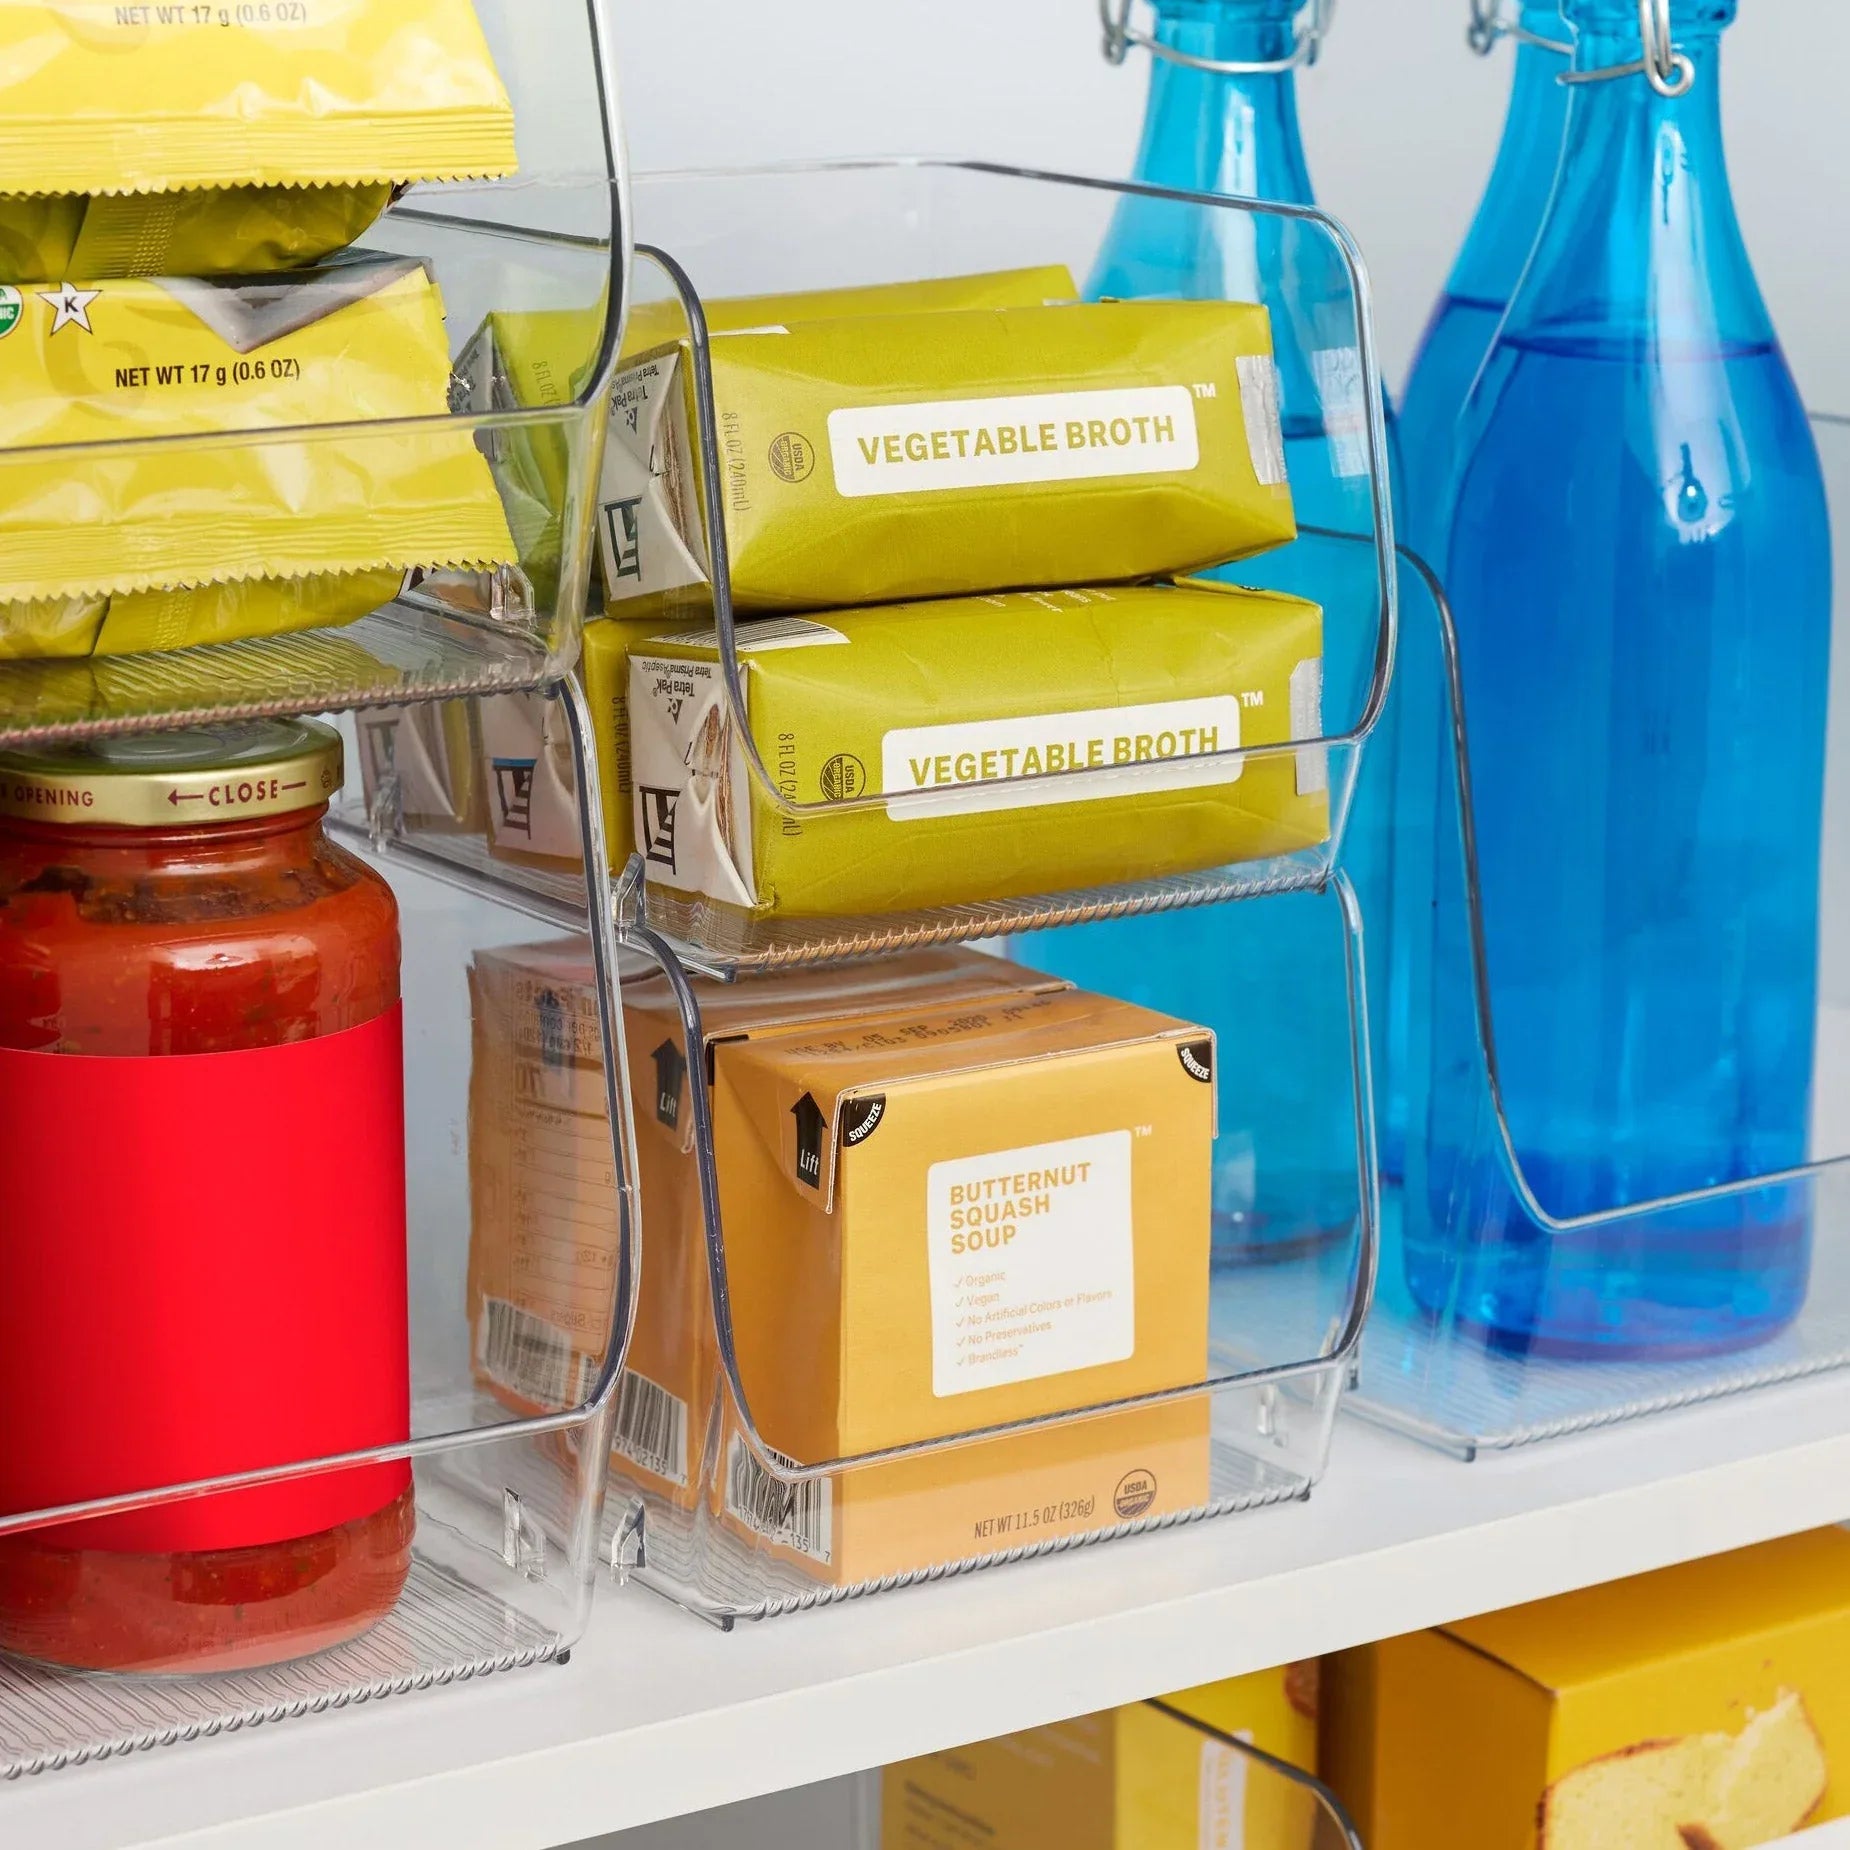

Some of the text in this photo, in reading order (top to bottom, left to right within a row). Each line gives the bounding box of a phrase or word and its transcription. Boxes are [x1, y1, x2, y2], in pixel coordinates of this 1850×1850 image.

[115, 2, 306, 27] NET WT 17 g (0.6 OZ)
[64, 296, 79, 313] K
[115, 358, 300, 387] NET WT 17 g (0.6 OZ)
[1193, 383, 1216, 398] TM
[721, 412, 738, 421] 8
[723, 423, 739, 437] FL
[857, 415, 1175, 465] VEGETABLE BROTH
[725, 440, 743, 454] OZ
[792, 443, 805, 471] USDA
[695, 665, 712, 679] Tetra
[674, 681, 695, 697] Tetra
[1241, 690, 1263, 706] TM
[778, 733, 794, 741] 8
[778, 745, 795, 758] FL
[908, 726, 1218, 787] VEGETABLE BROTH
[779, 761, 796, 776] OZ
[845, 765, 855, 793] USDA
[14, 785, 94, 807] OPENING
[208, 779, 279, 807] CLOSE
[1181, 1047, 1210, 1080] SQUEEZE
[659, 1091, 677, 1117] Lift
[848, 1102, 882, 1141] SQUEEZE
[799, 1148, 820, 1176] Lift
[950, 1162, 1091, 1206] BUTTERNUT
[950, 1194, 1050, 1230] SQUASH
[951, 1225, 1017, 1255] SOUP
[965, 1271, 1006, 1287] Organic
[967, 1292, 1000, 1307] Vegan
[967, 1290, 1112, 1326] No Artificial Colors or Flavors
[968, 1321, 1052, 1345] No Preservatives
[1124, 1480, 1148, 1495] USDA
[975, 1518, 995, 1539] NET
[998, 1515, 1013, 1533] WT
[1016, 1508, 1040, 1530] 11.5
[1043, 1506, 1056, 1524] OZ
[1059, 1495, 1095, 1521] (326g)
